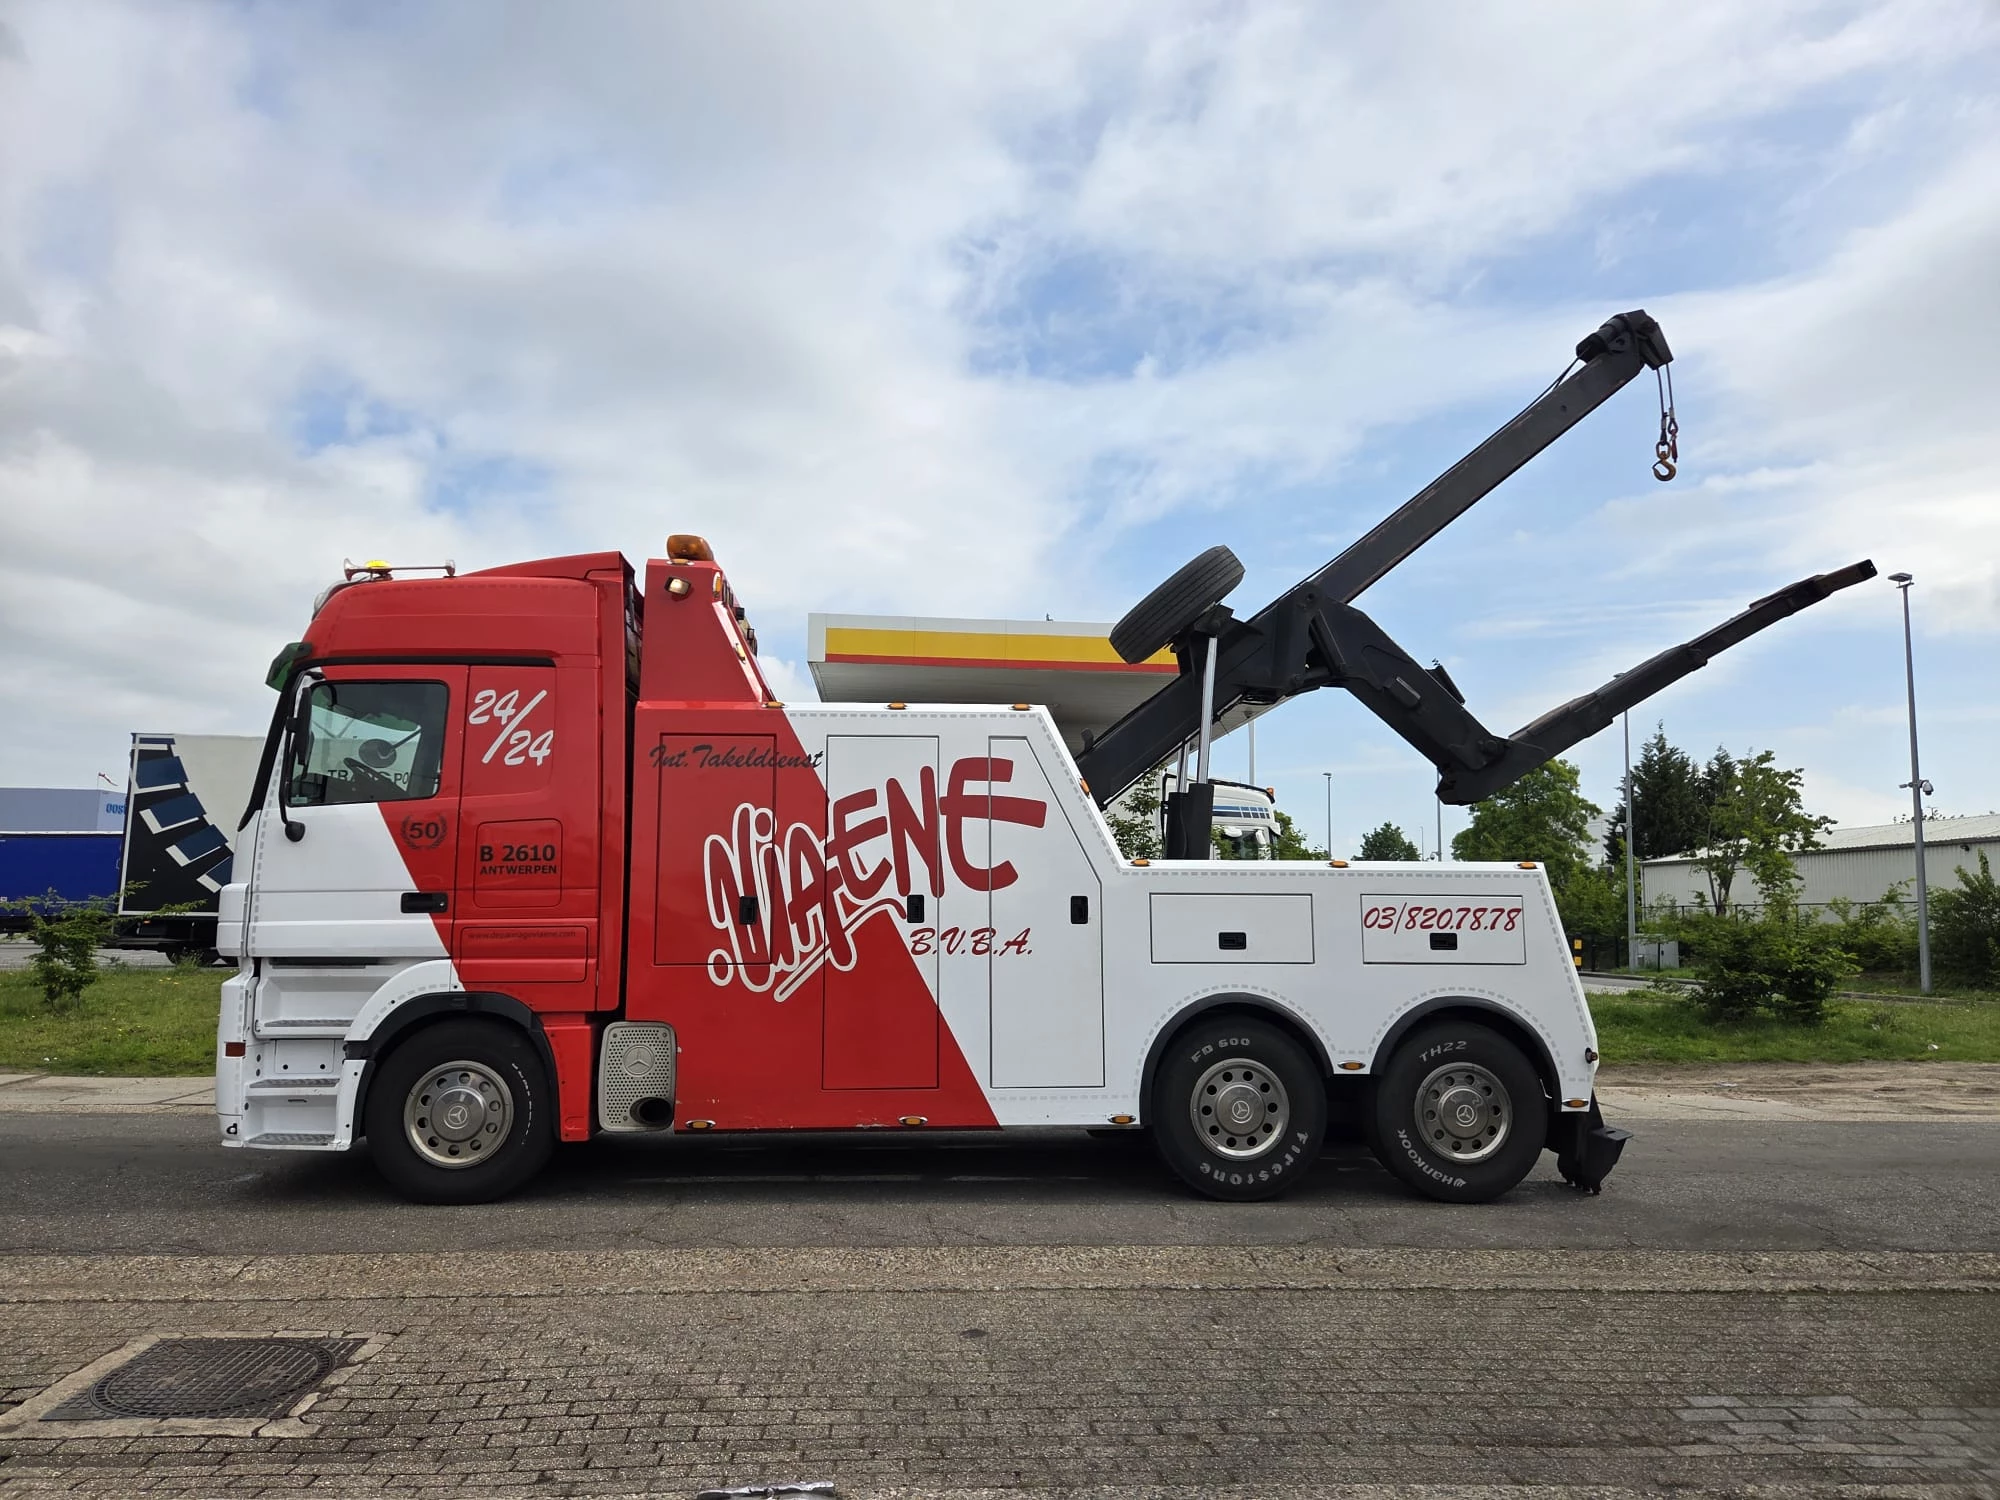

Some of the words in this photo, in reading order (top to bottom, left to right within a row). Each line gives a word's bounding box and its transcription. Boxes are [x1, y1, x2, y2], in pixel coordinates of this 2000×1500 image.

[649, 744, 689, 768] Int.
[692, 744, 823, 768] Takeldienst
[410, 821, 440, 839] 50
[479, 845, 494, 862] B
[502, 844, 556, 862] 2610
[479, 864, 557, 876] ANTWERPEN
[909, 926, 1033, 957] B.V.B.A.
[1218, 1037, 1250, 1048] 600
[1419, 1040, 1467, 1062] TH22
